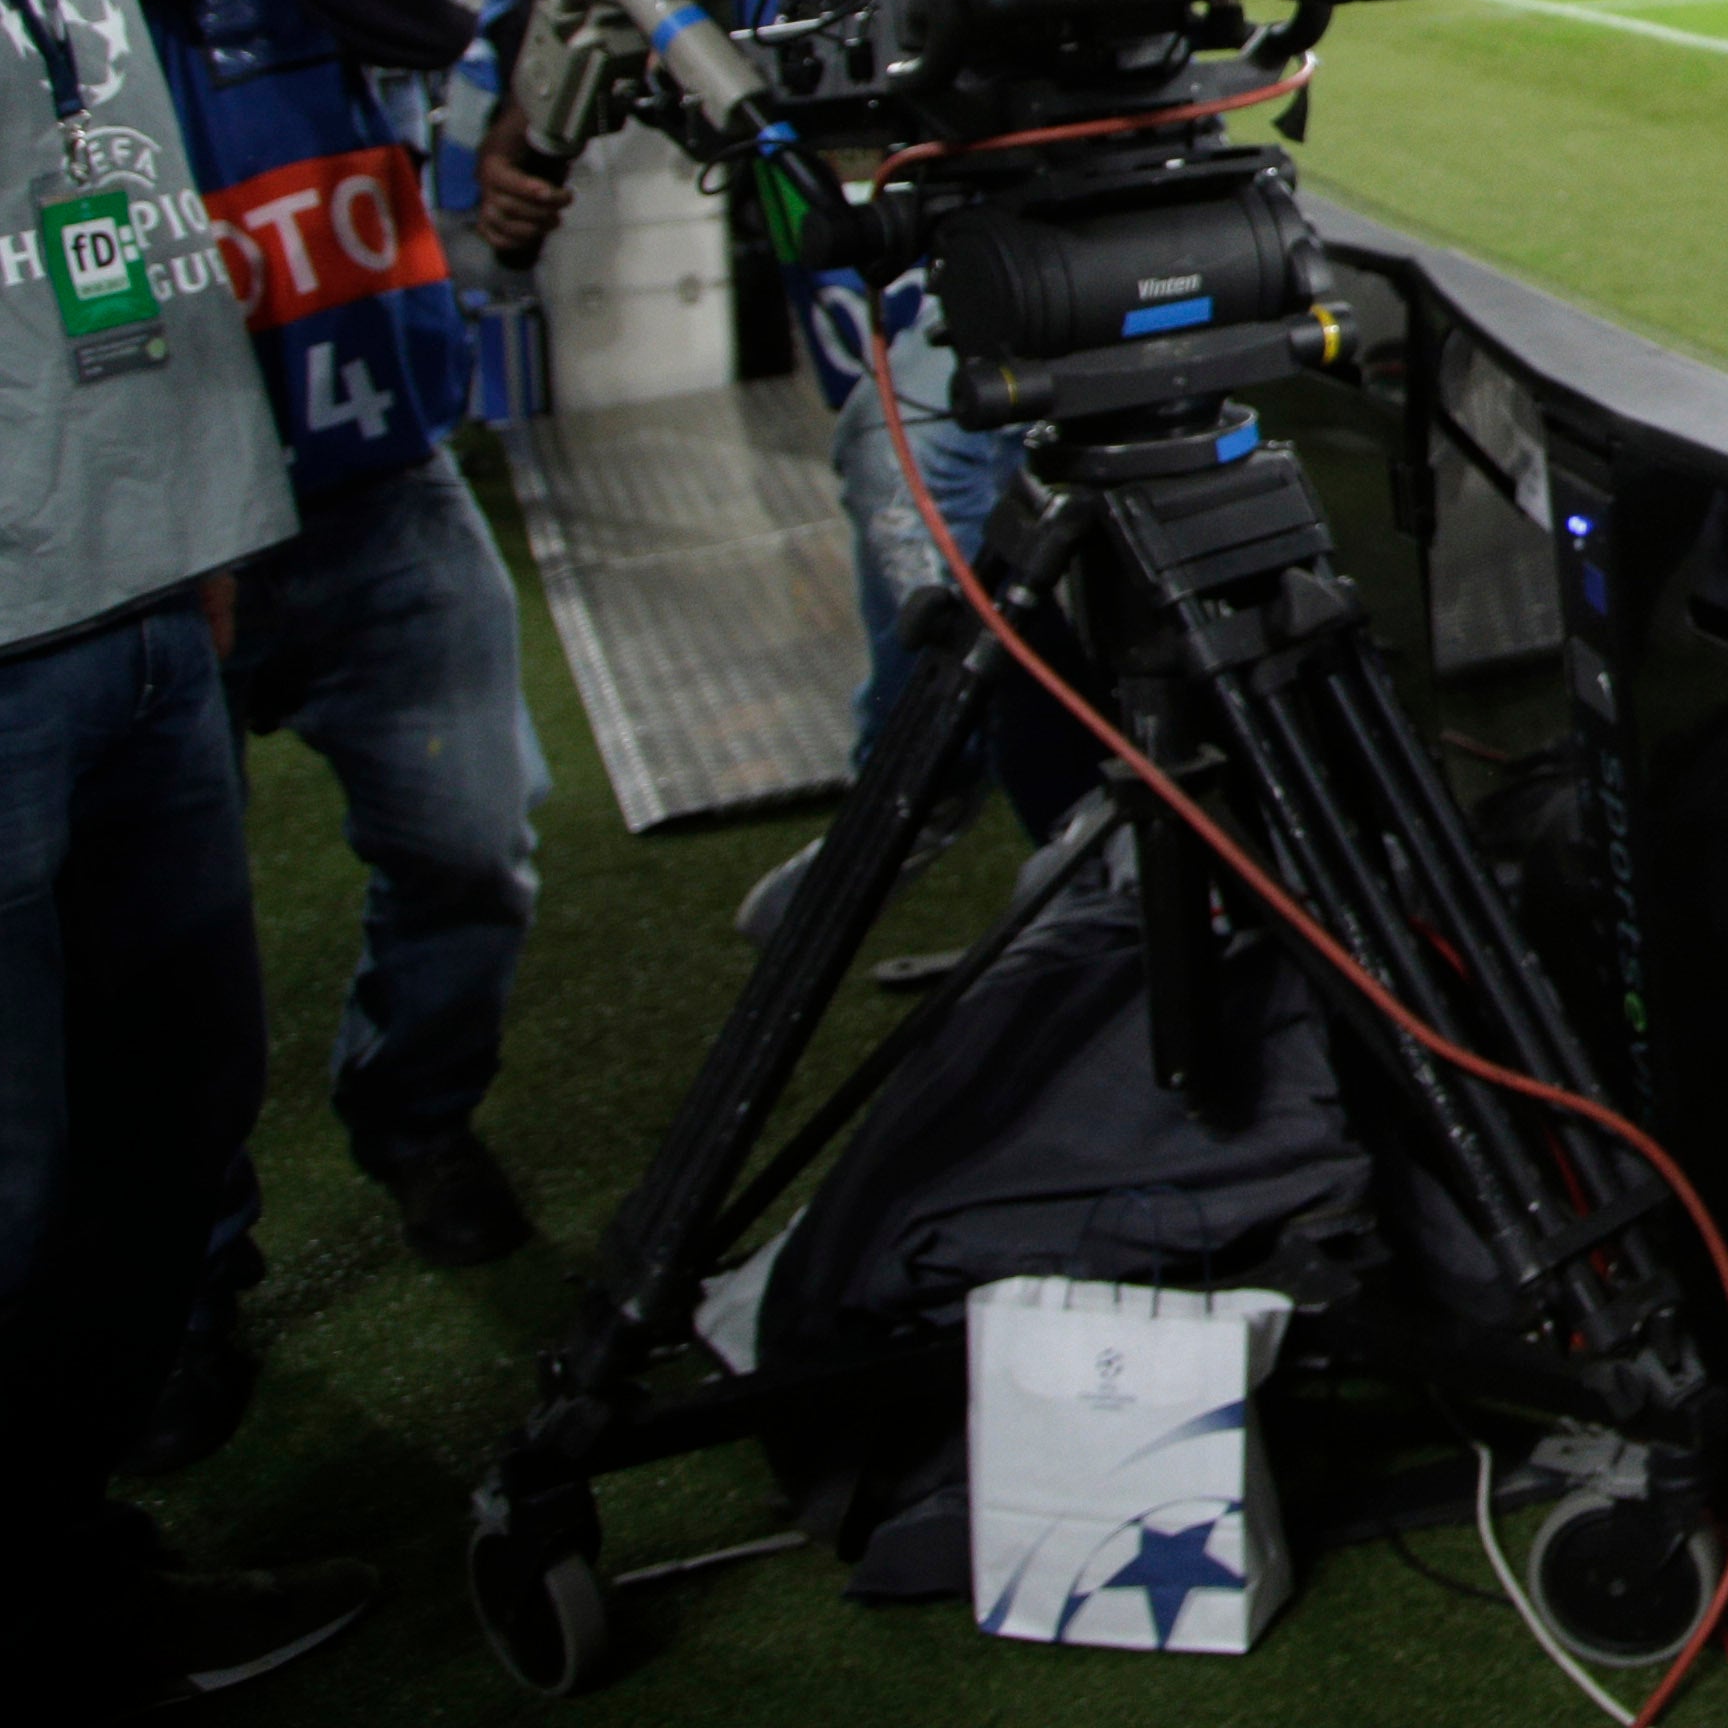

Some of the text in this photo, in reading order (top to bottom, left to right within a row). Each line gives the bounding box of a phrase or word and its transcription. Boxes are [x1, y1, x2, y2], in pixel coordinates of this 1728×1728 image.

[62, 136, 157, 180] EFA
[1137, 274, 1202, 300] Vinten
[306, 341, 394, 441] 4
